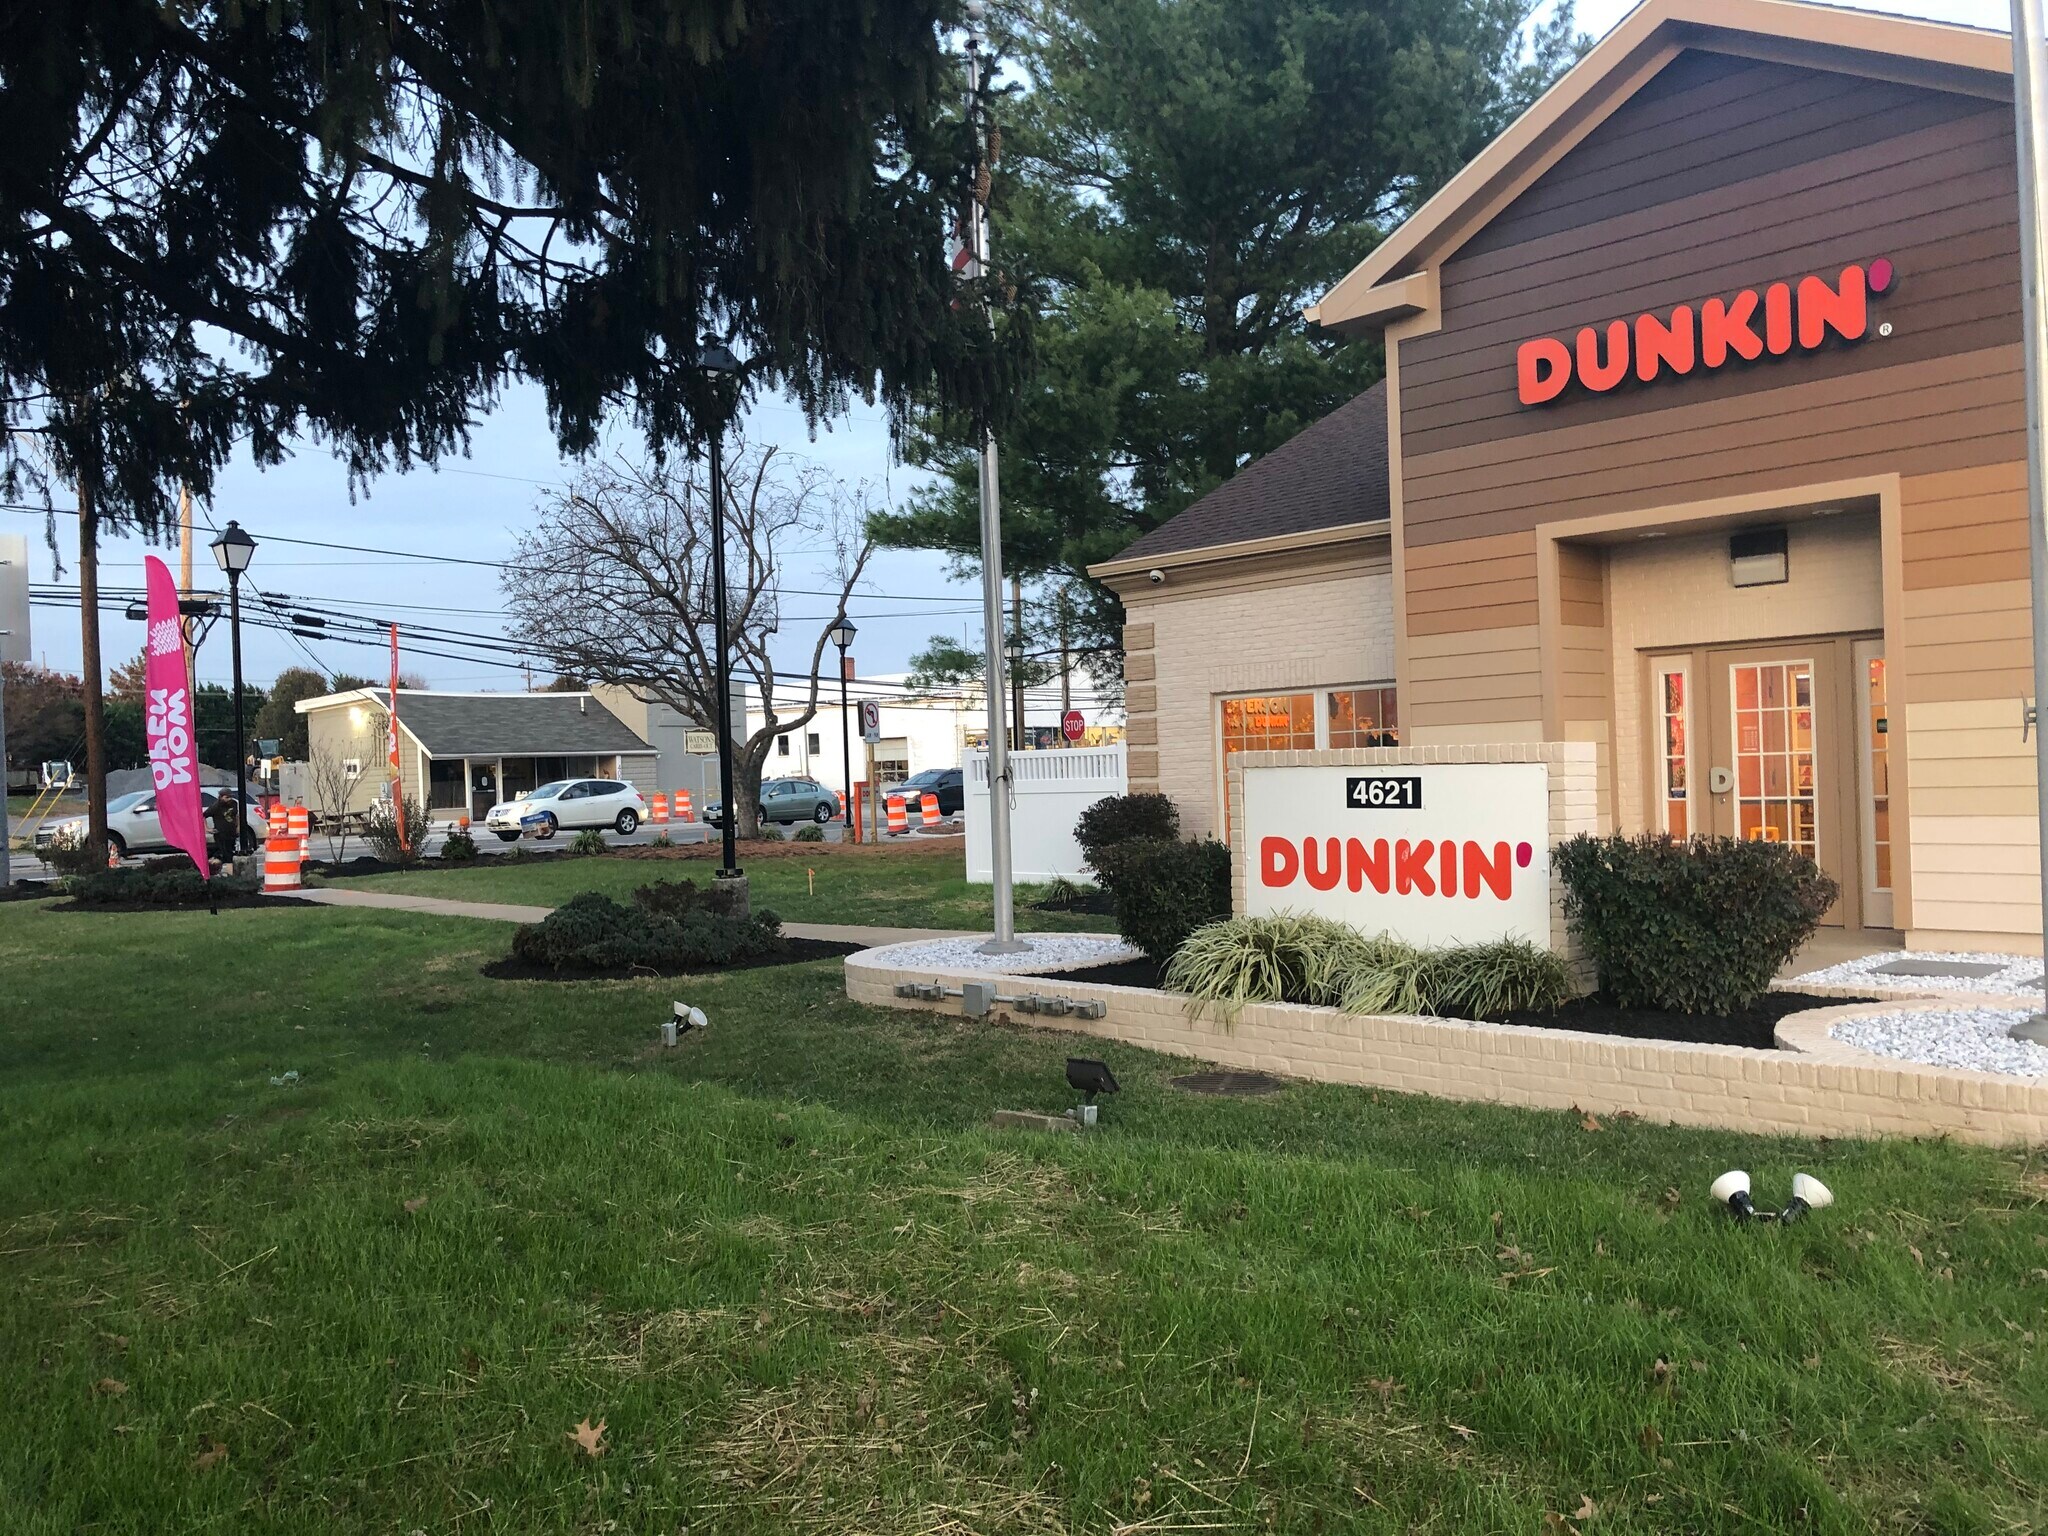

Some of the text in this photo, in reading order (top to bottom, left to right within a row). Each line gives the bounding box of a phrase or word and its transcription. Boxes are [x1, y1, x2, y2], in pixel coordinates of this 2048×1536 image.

[1516, 257, 1893, 405] DUNKIN'
[1065, 719, 1084, 732] STOP
[1353, 780, 1413, 805] 4621
[1261, 836, 1532, 901] DUNKIN'
